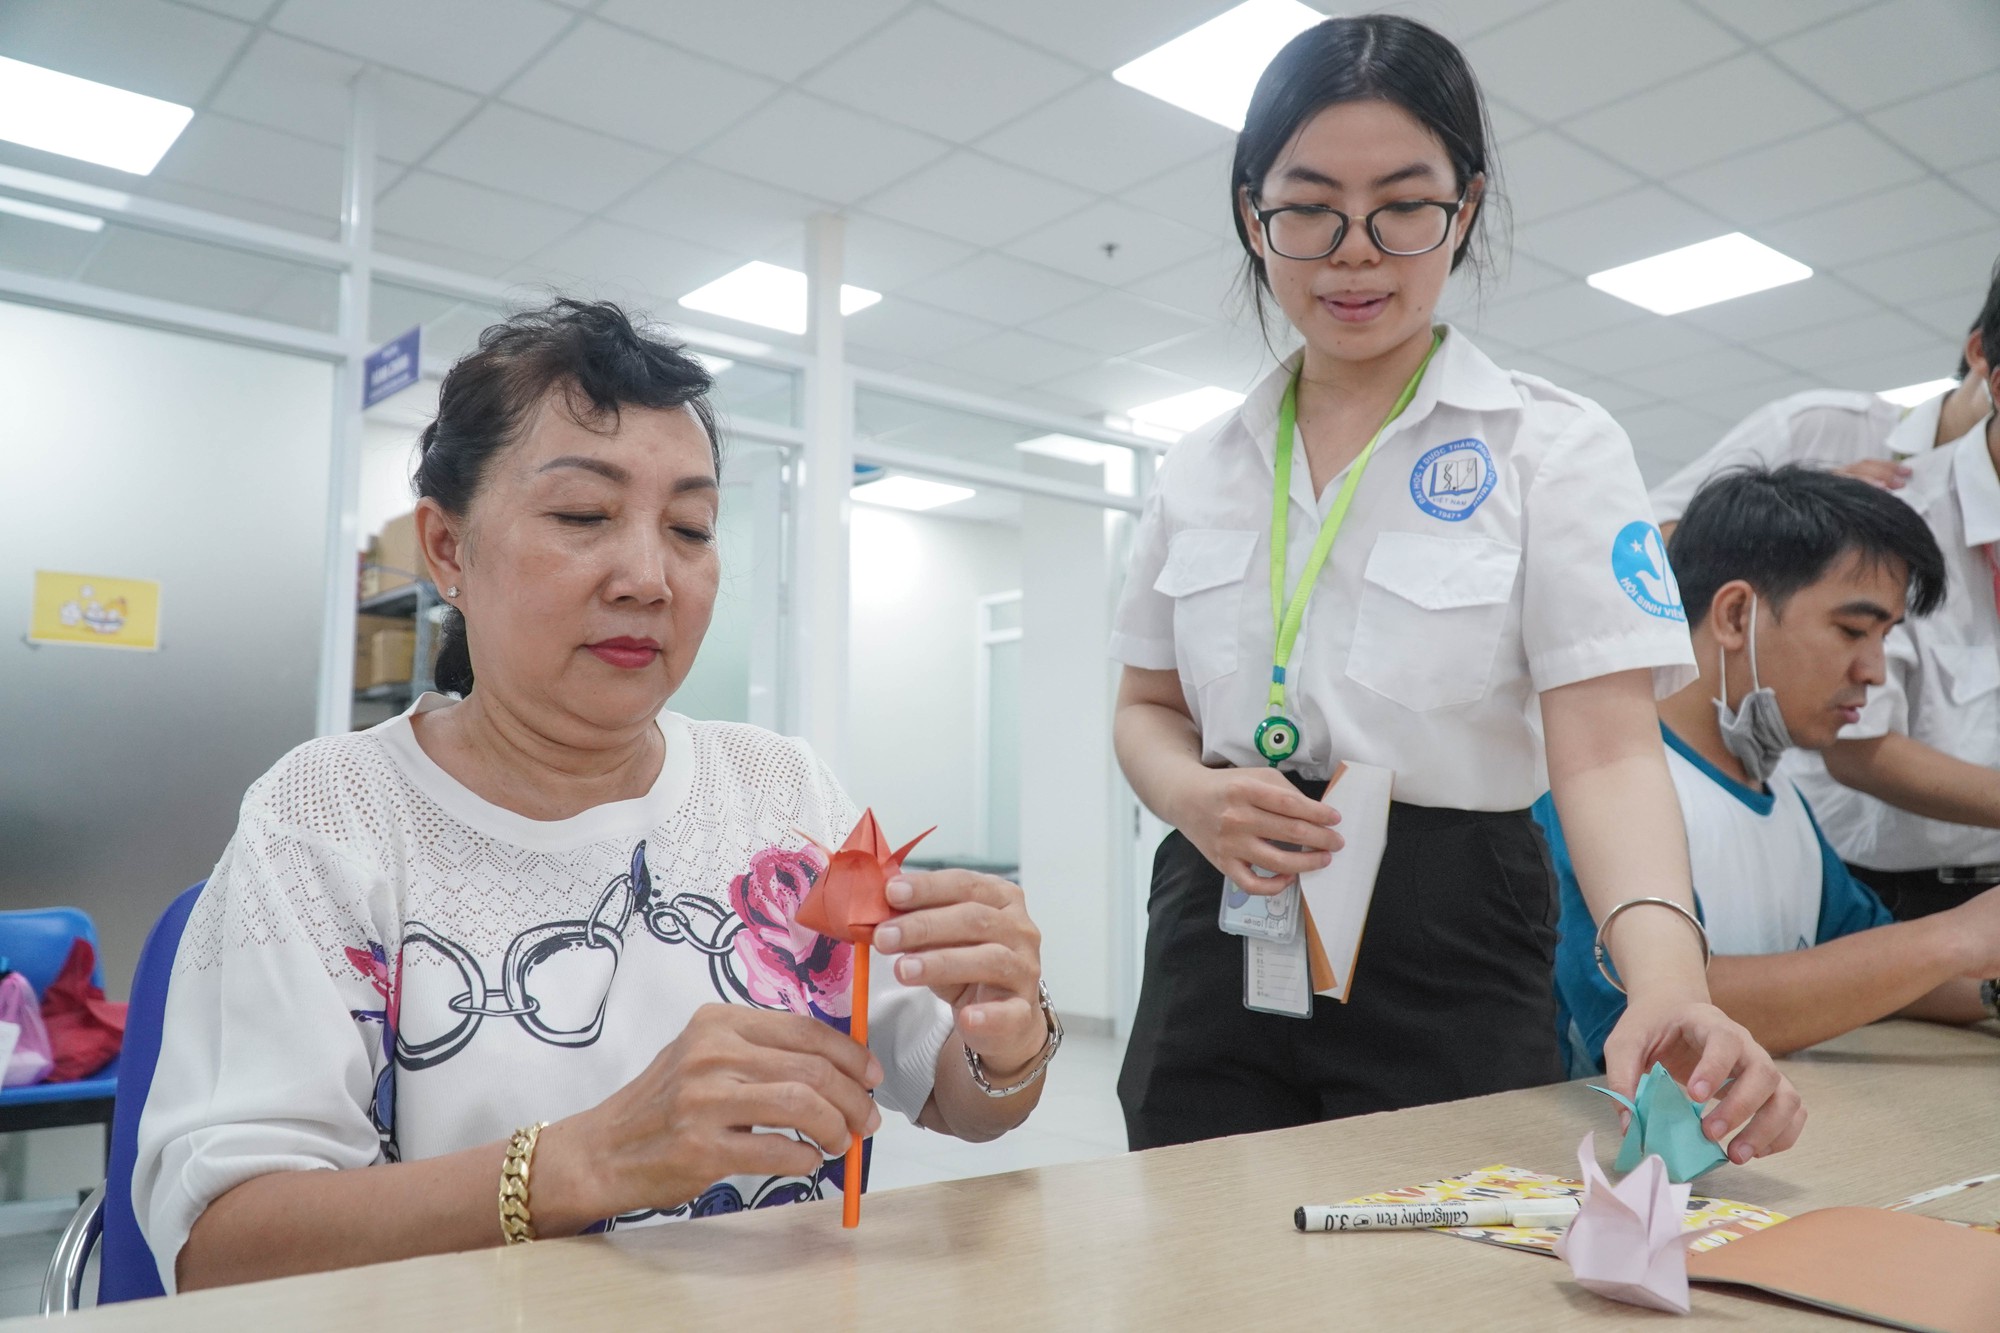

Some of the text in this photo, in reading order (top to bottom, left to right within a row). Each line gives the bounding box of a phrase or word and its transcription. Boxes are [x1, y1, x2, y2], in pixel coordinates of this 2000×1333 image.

[1637, 595, 1662, 615] SINH
[1324, 1207, 1469, 1231] Calligraphy Pen 3.0
